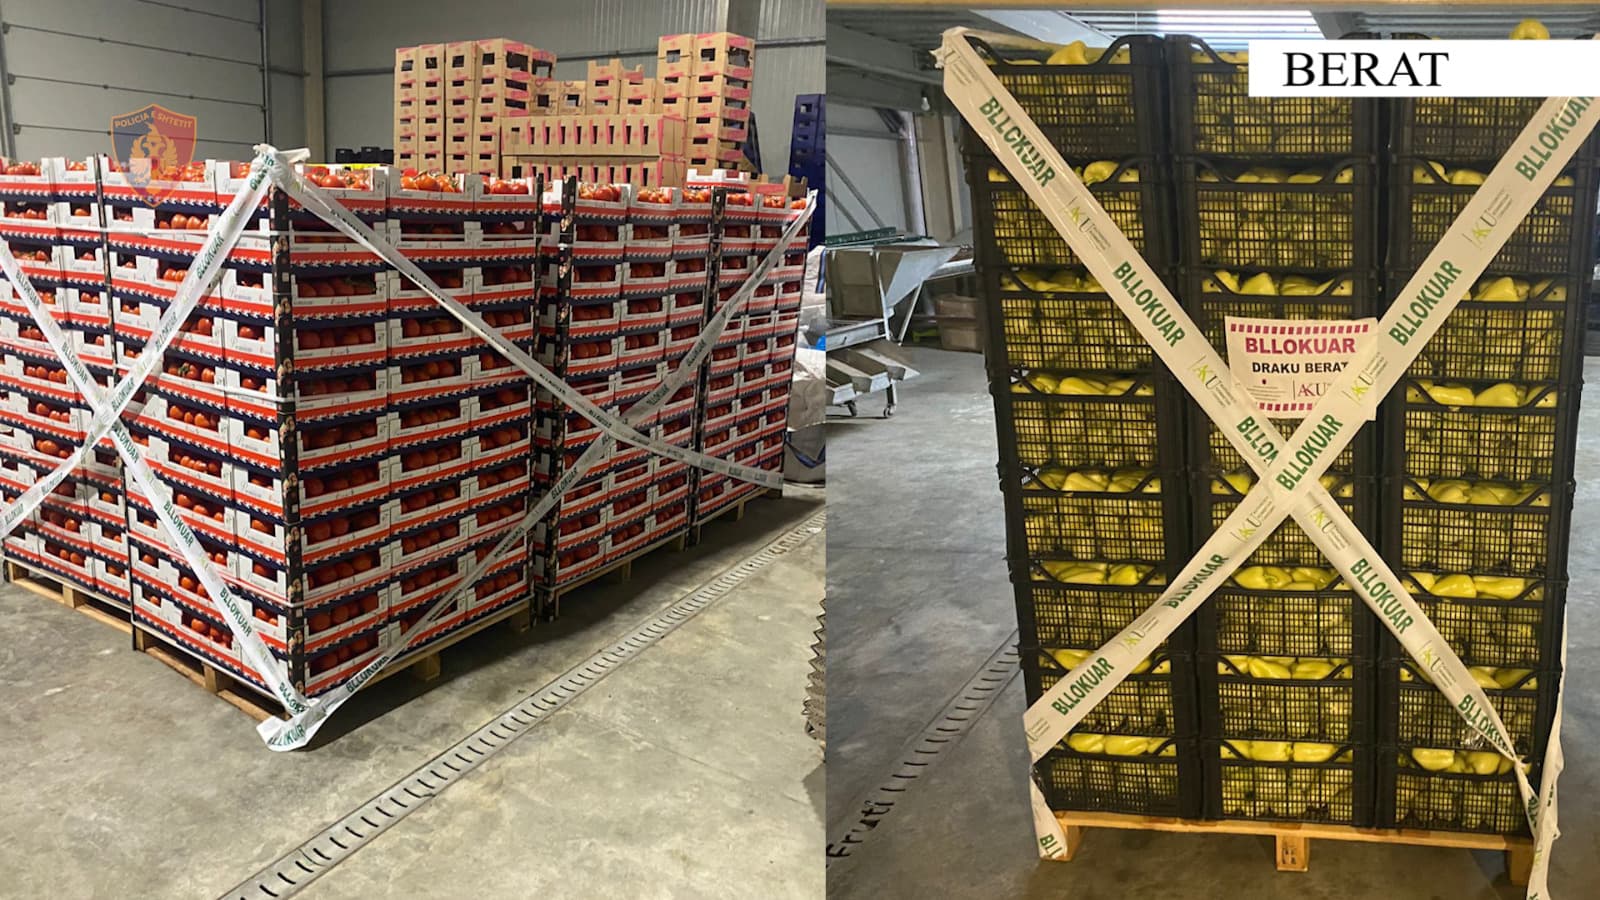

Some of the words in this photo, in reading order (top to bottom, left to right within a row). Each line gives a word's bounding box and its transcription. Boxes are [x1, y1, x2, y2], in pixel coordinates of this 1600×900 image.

[1113, 261, 1186, 347] BLLOKUAR
[1388, 260, 1463, 346] BLLOKUAR
[62, 342, 89, 385] BLLOKUAR
[1245, 337, 1356, 355] BLLOKUAR
[1252, 361, 1300, 374] DRAKU
[1276, 414, 1344, 491] BLLOKUAR
[162, 500, 195, 548] BLLOKUAR
[219, 587, 253, 638] BLLOKUAR
[1350, 558, 1414, 634] BLLOKUAR
[1051, 657, 1116, 717] BLLOKUAR
